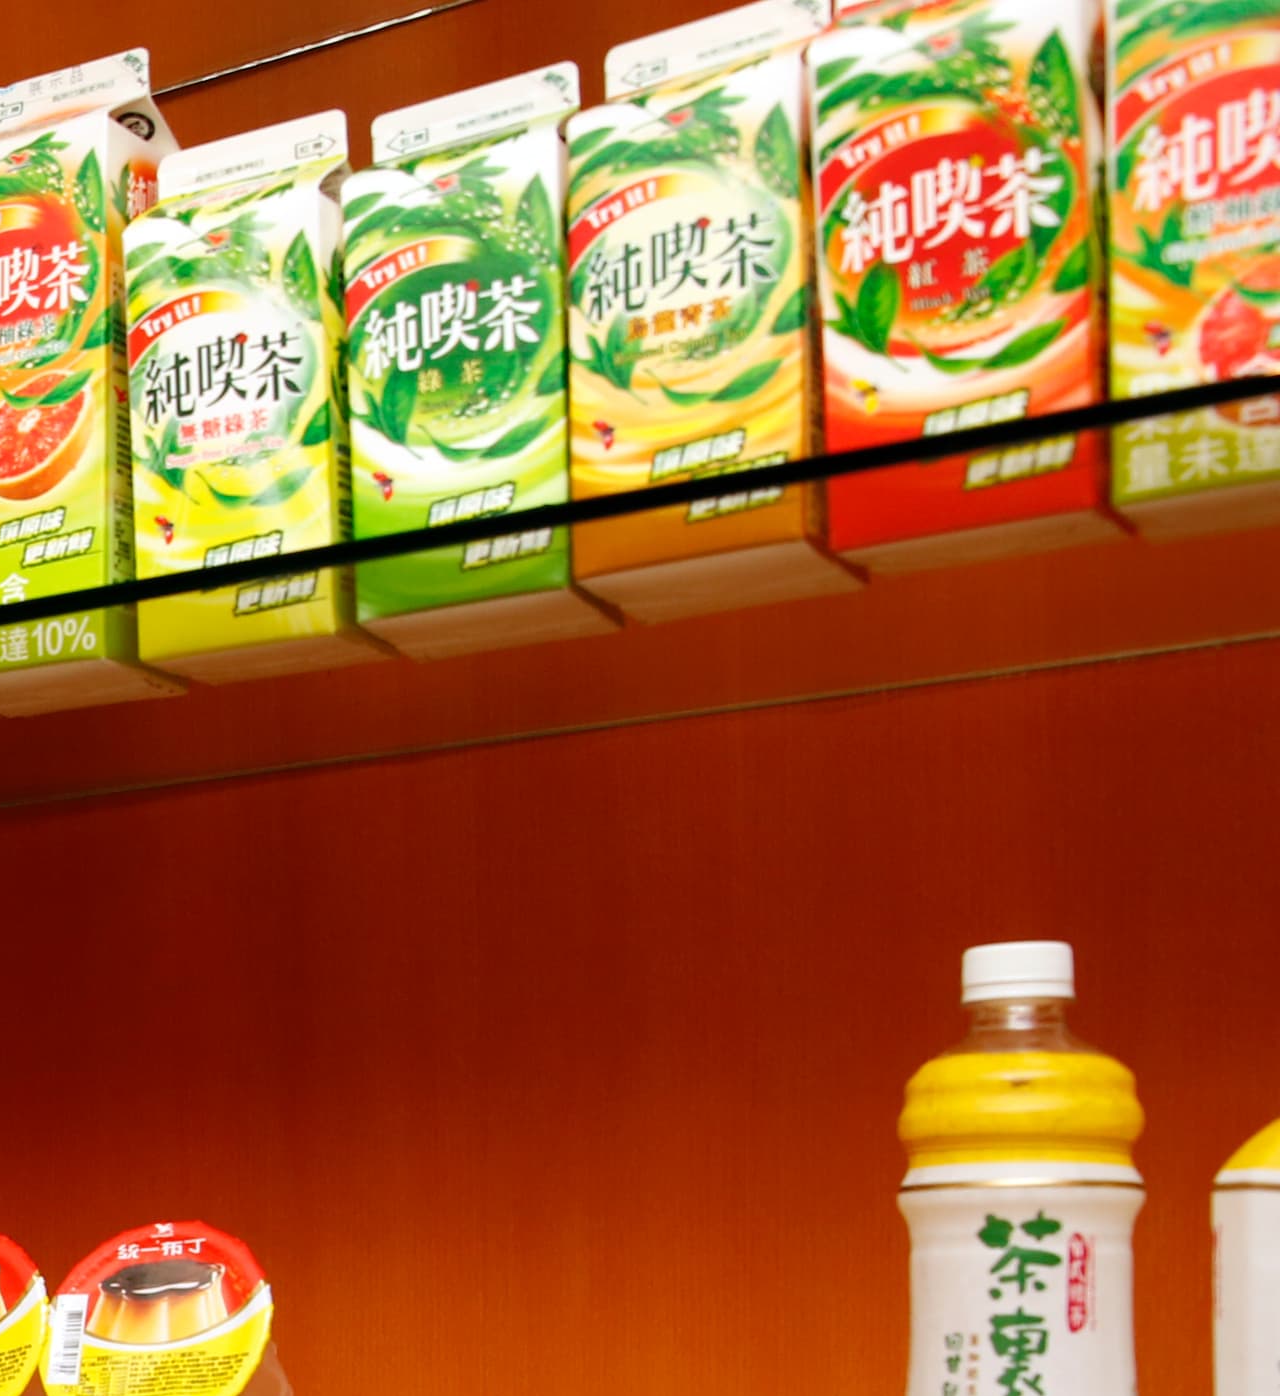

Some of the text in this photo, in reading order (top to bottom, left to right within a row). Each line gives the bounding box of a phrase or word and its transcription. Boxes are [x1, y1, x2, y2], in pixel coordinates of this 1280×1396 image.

[584, 200, 624, 229] Try
[840, 146, 1065, 274] 純喫茶
[359, 261, 397, 291] Try
[590, 212, 775, 322] 純喫茶
[139, 295, 202, 339] Try it!
[363, 274, 542, 380] 純喫茶
[144, 331, 304, 427] 純喫茶
[117, 1237, 207, 1261] 統一布丁
